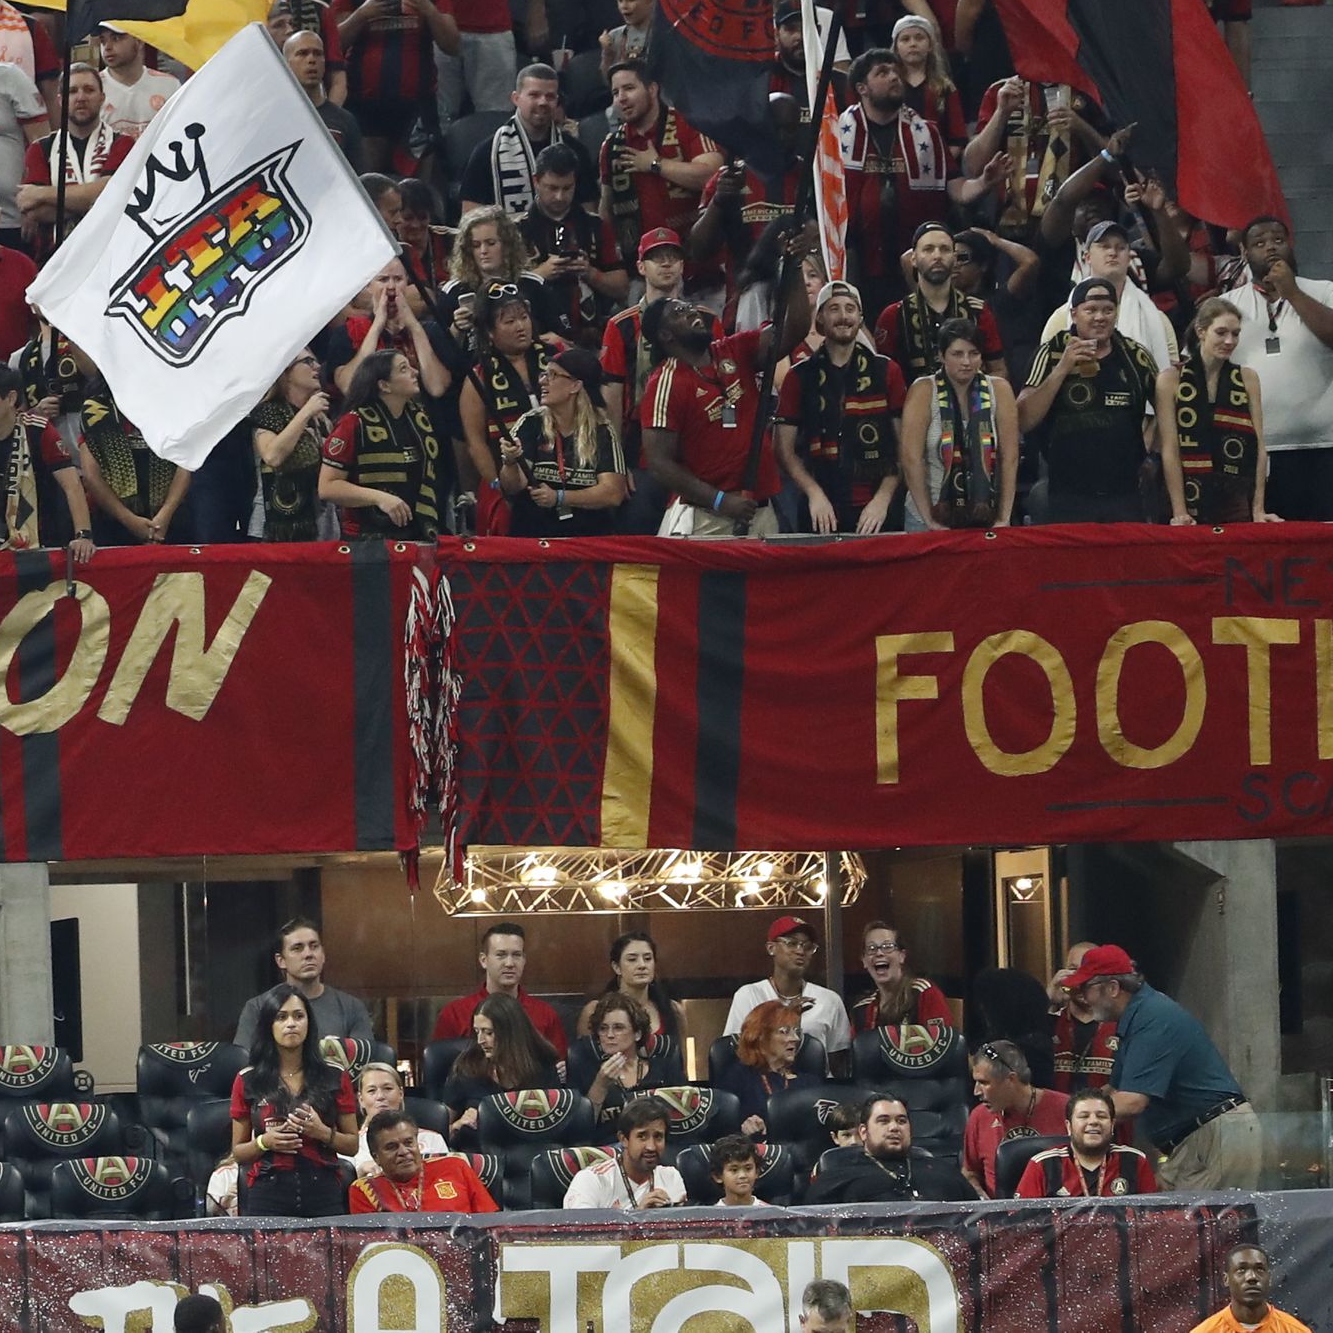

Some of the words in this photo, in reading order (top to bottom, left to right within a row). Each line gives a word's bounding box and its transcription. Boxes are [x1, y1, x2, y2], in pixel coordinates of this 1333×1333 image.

[493, 125, 532, 214] UNITE
[1224, 555, 1333, 608] NE
[875, 617, 1333, 784] FOOT
[889, 1046, 934, 1069] UNITED
[933, 1033, 949, 1054] FC
[36, 1061, 52, 1078] FC
[34, 1119, 79, 1144] UNITED
[79, 1119, 96, 1137] FC
[502, 1105, 547, 1131] UNITED
[548, 1104, 565, 1122] FC
[83, 1176, 128, 1199] UNITED
[129, 1170, 144, 1190] FC
